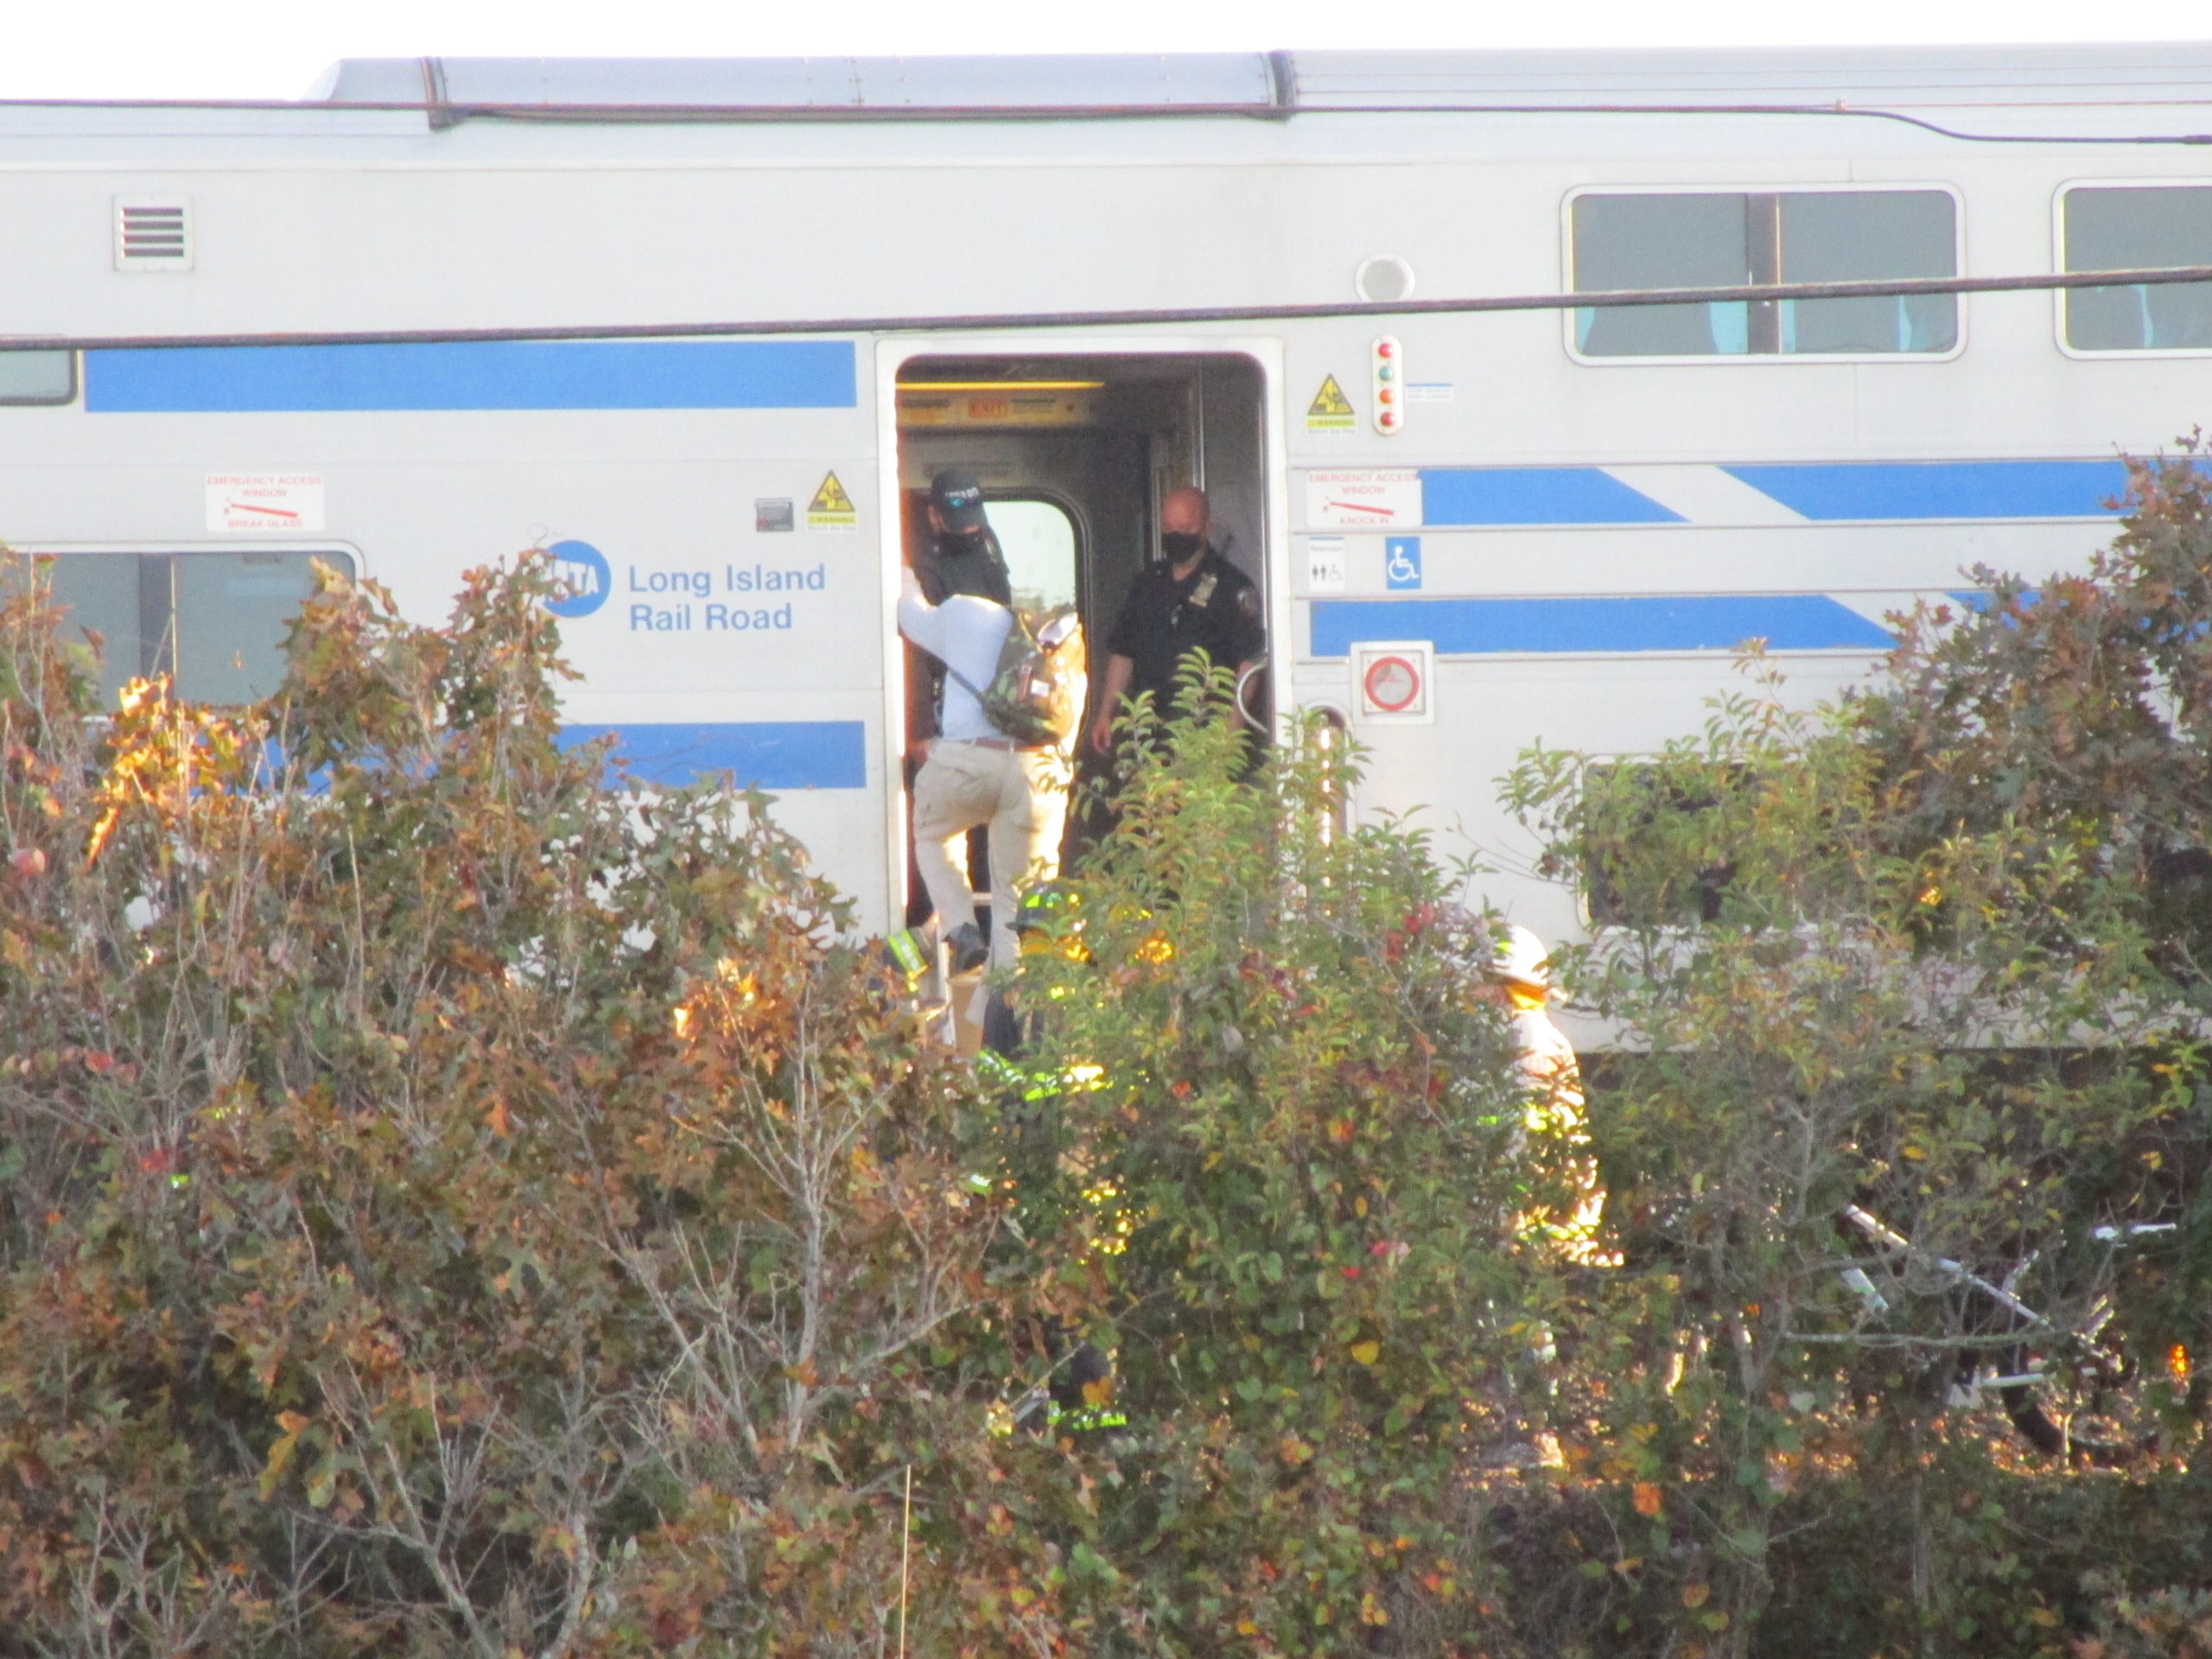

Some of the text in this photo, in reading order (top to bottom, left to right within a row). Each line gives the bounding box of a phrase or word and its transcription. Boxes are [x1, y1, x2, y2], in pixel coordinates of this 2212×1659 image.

[207, 476, 321, 485] EMERGENCY ACCESS
[1309, 473, 1417, 482] EMERGENCY ACCESS
[243, 489, 287, 498] WINDOW
[1341, 486, 1385, 494] WINDOW
[629, 563, 825, 599] Long Island
[629, 602, 792, 631] Rail Road
